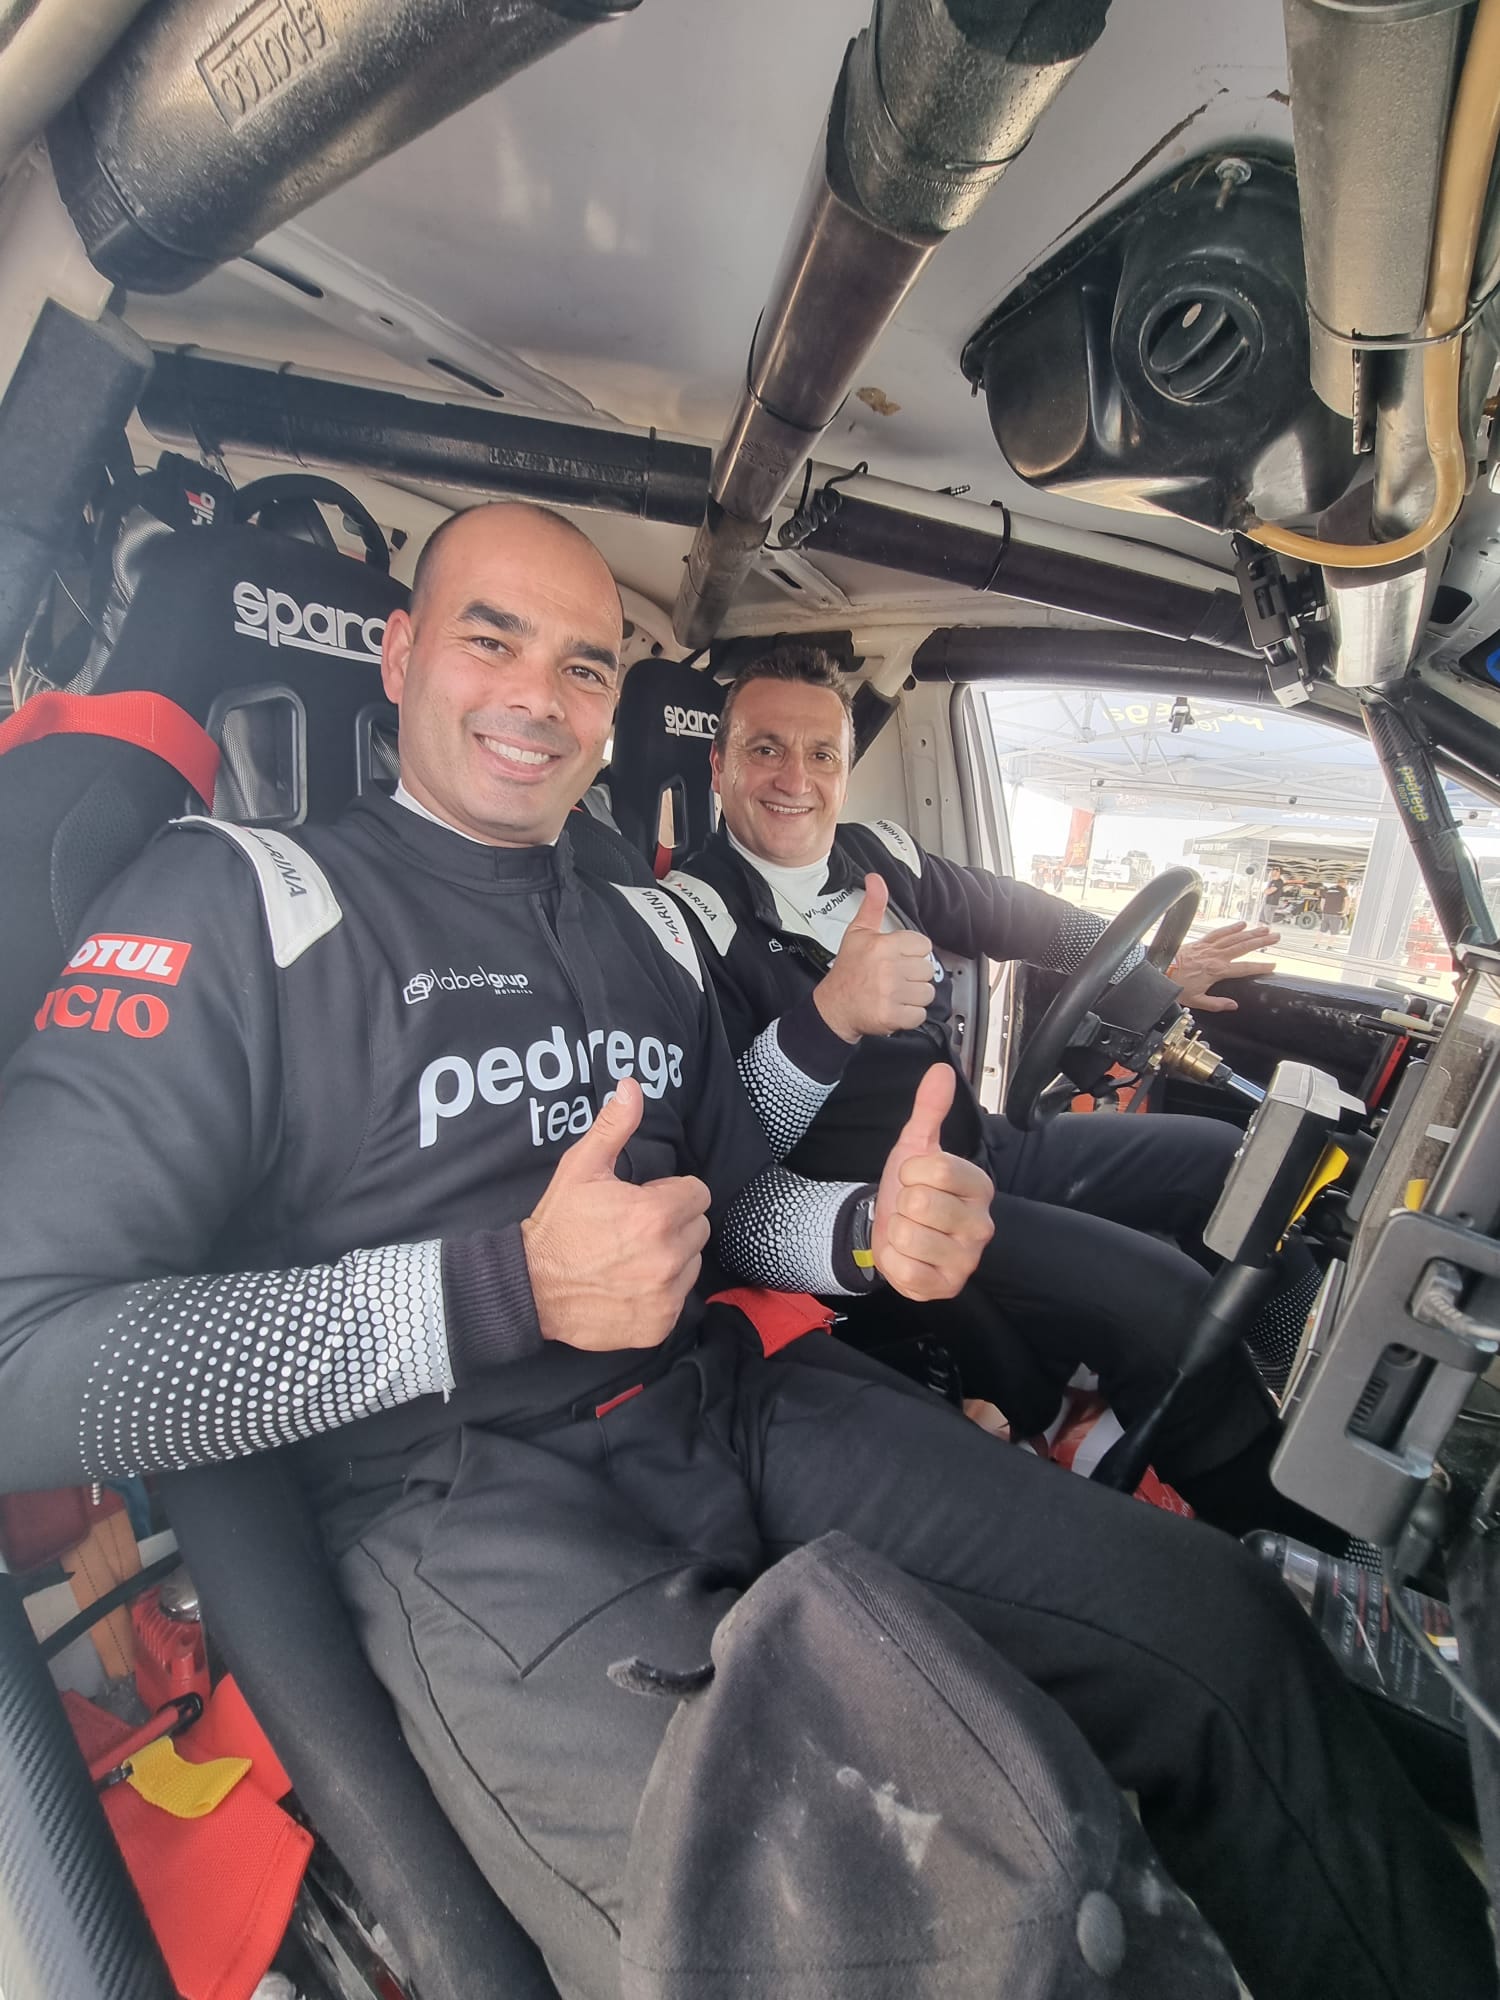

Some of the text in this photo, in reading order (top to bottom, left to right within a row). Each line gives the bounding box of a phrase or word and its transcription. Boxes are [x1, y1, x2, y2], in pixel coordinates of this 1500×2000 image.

[233, 581, 386, 657] sparc
[664, 705, 720, 737] sparc
[1395, 766, 1429, 821] pedrega
[641, 890, 685, 945] MARINA
[674, 883, 718, 921] MARINA
[69, 939, 174, 977] OTUL
[418, 1025, 685, 1149] pedrega
[529, 1090, 618, 1147] tea
